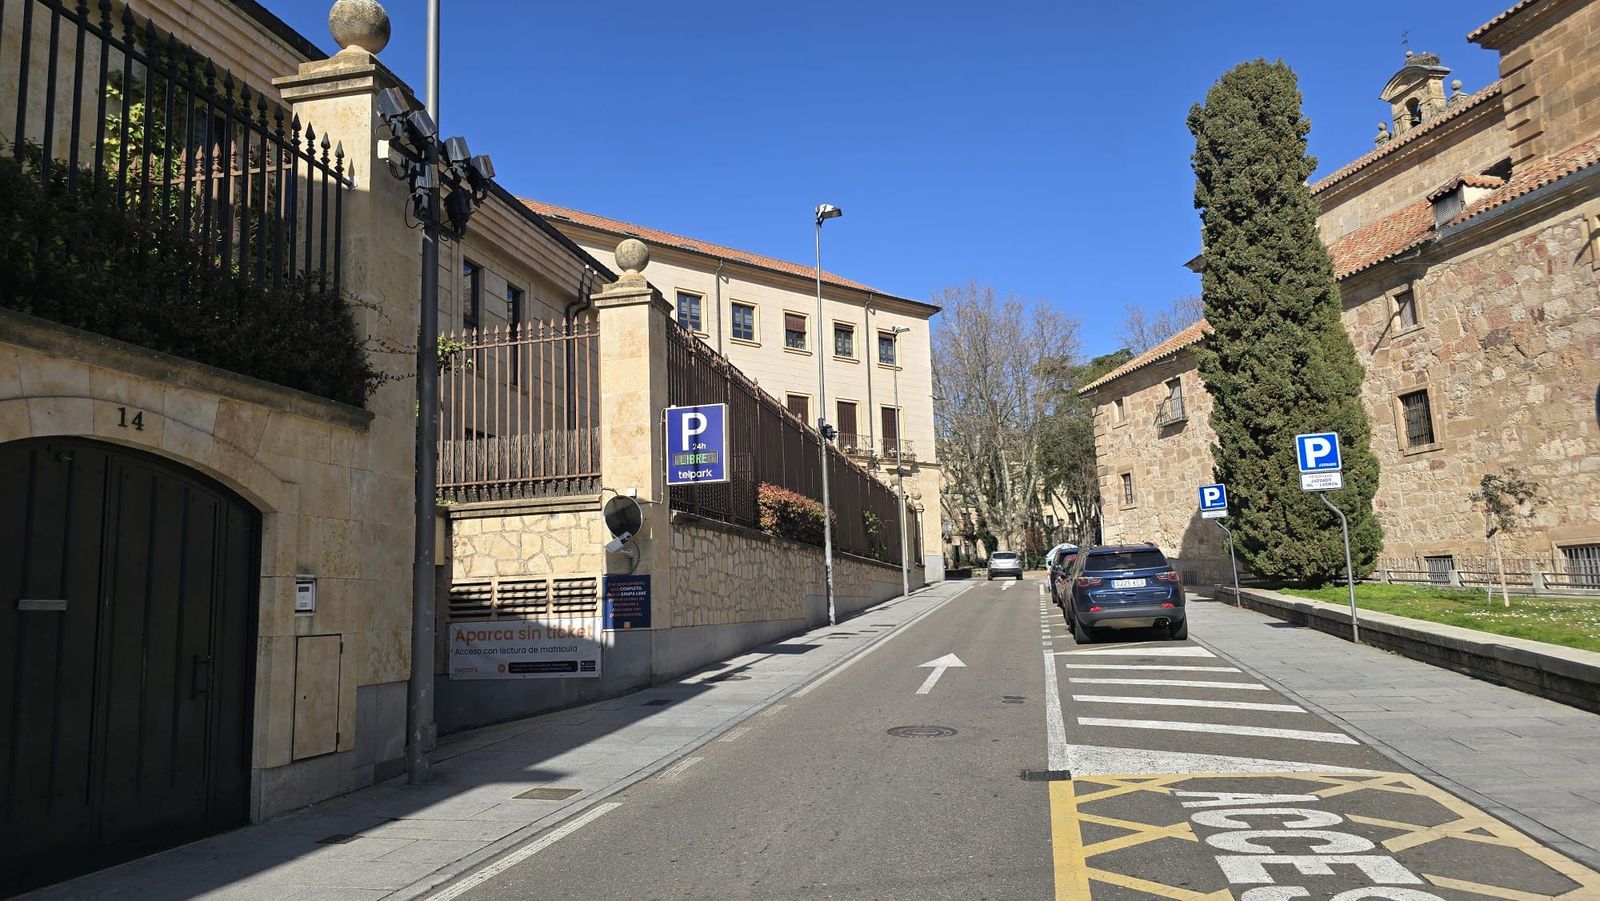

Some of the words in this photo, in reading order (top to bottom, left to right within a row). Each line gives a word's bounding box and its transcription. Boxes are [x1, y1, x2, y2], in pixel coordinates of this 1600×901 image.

[117, 407, 145, 431] 14
[682, 412, 707, 451] P
[680, 453, 708, 465] LIBRE
[1304, 437, 1331, 468] P
[678, 469, 713, 480] telpark
[1203, 487, 1220, 507] P
[455, 627, 514, 646] Aparca
[518, 626, 541, 640] sin
[546, 623, 593, 639] ticket
[454, 647, 482, 655] Acceso
[499, 646, 527, 654] lectura
[528, 646, 538, 654] de
